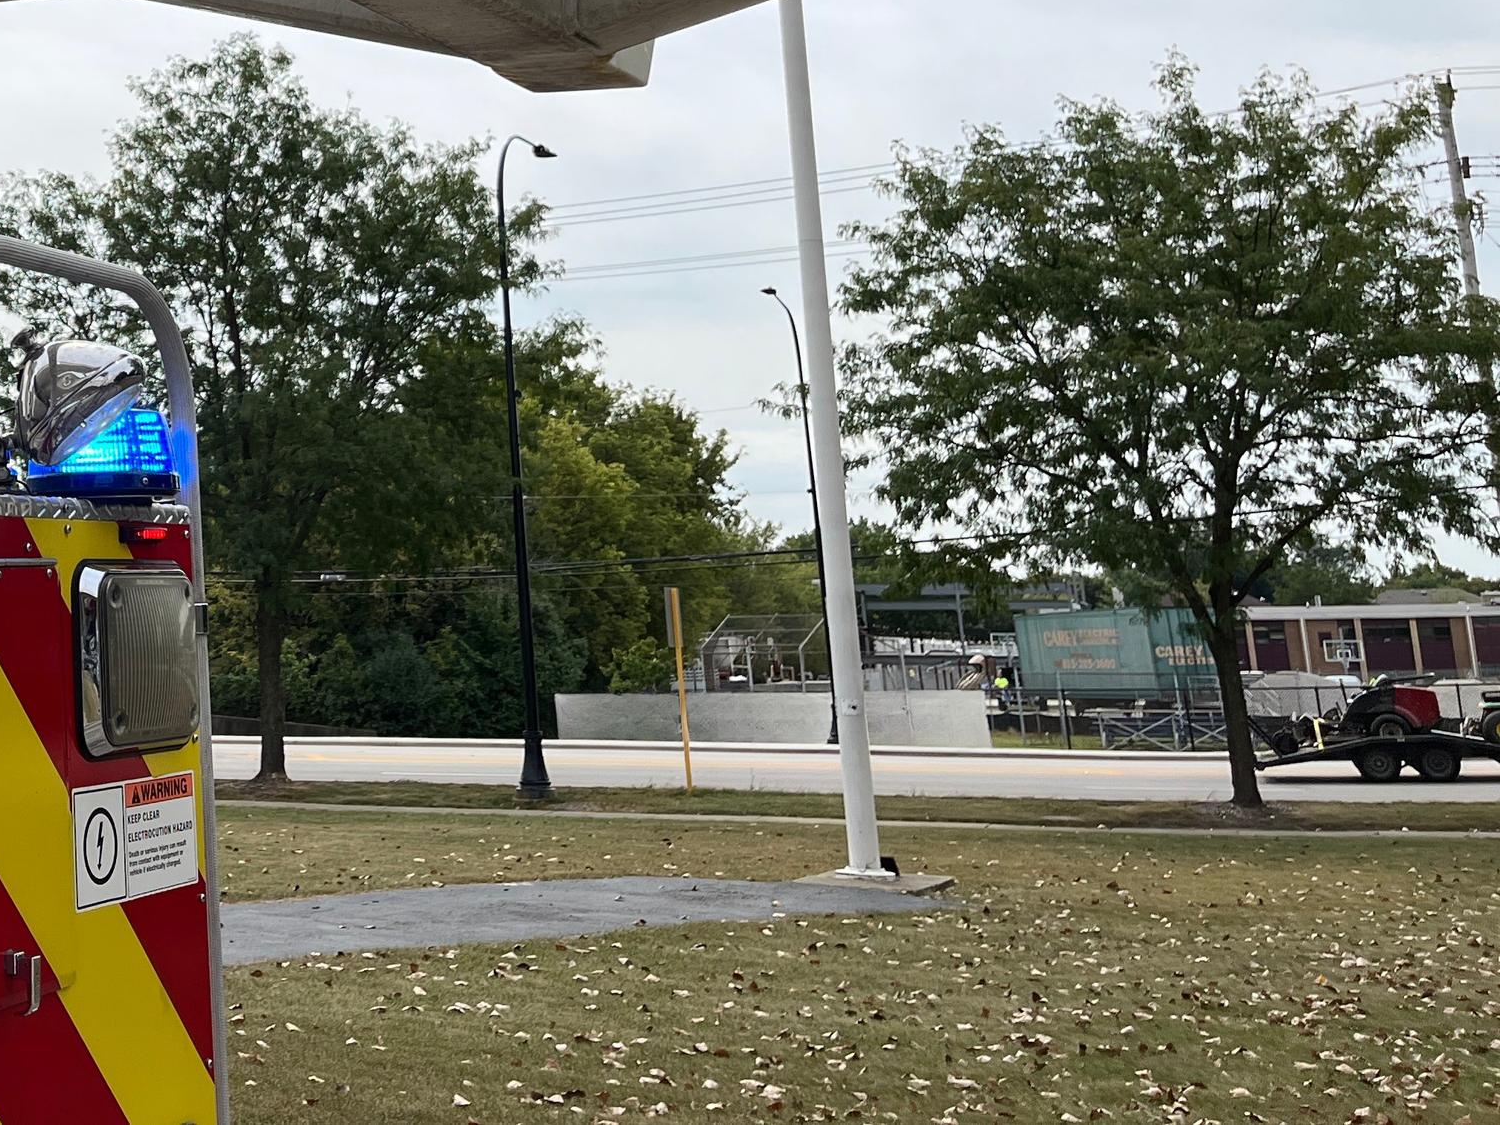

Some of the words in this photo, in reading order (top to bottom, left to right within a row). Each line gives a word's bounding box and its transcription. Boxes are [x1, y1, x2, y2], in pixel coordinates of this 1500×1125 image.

[1155, 645, 1204, 658] CAREY
[140, 778, 187, 801] WARNING
[127, 813, 141, 824] KEEP
[142, 809, 160, 822] CLEAR
[128, 825, 171, 843] ELECTROCUTION
[172, 819, 192, 833] HAZARD
